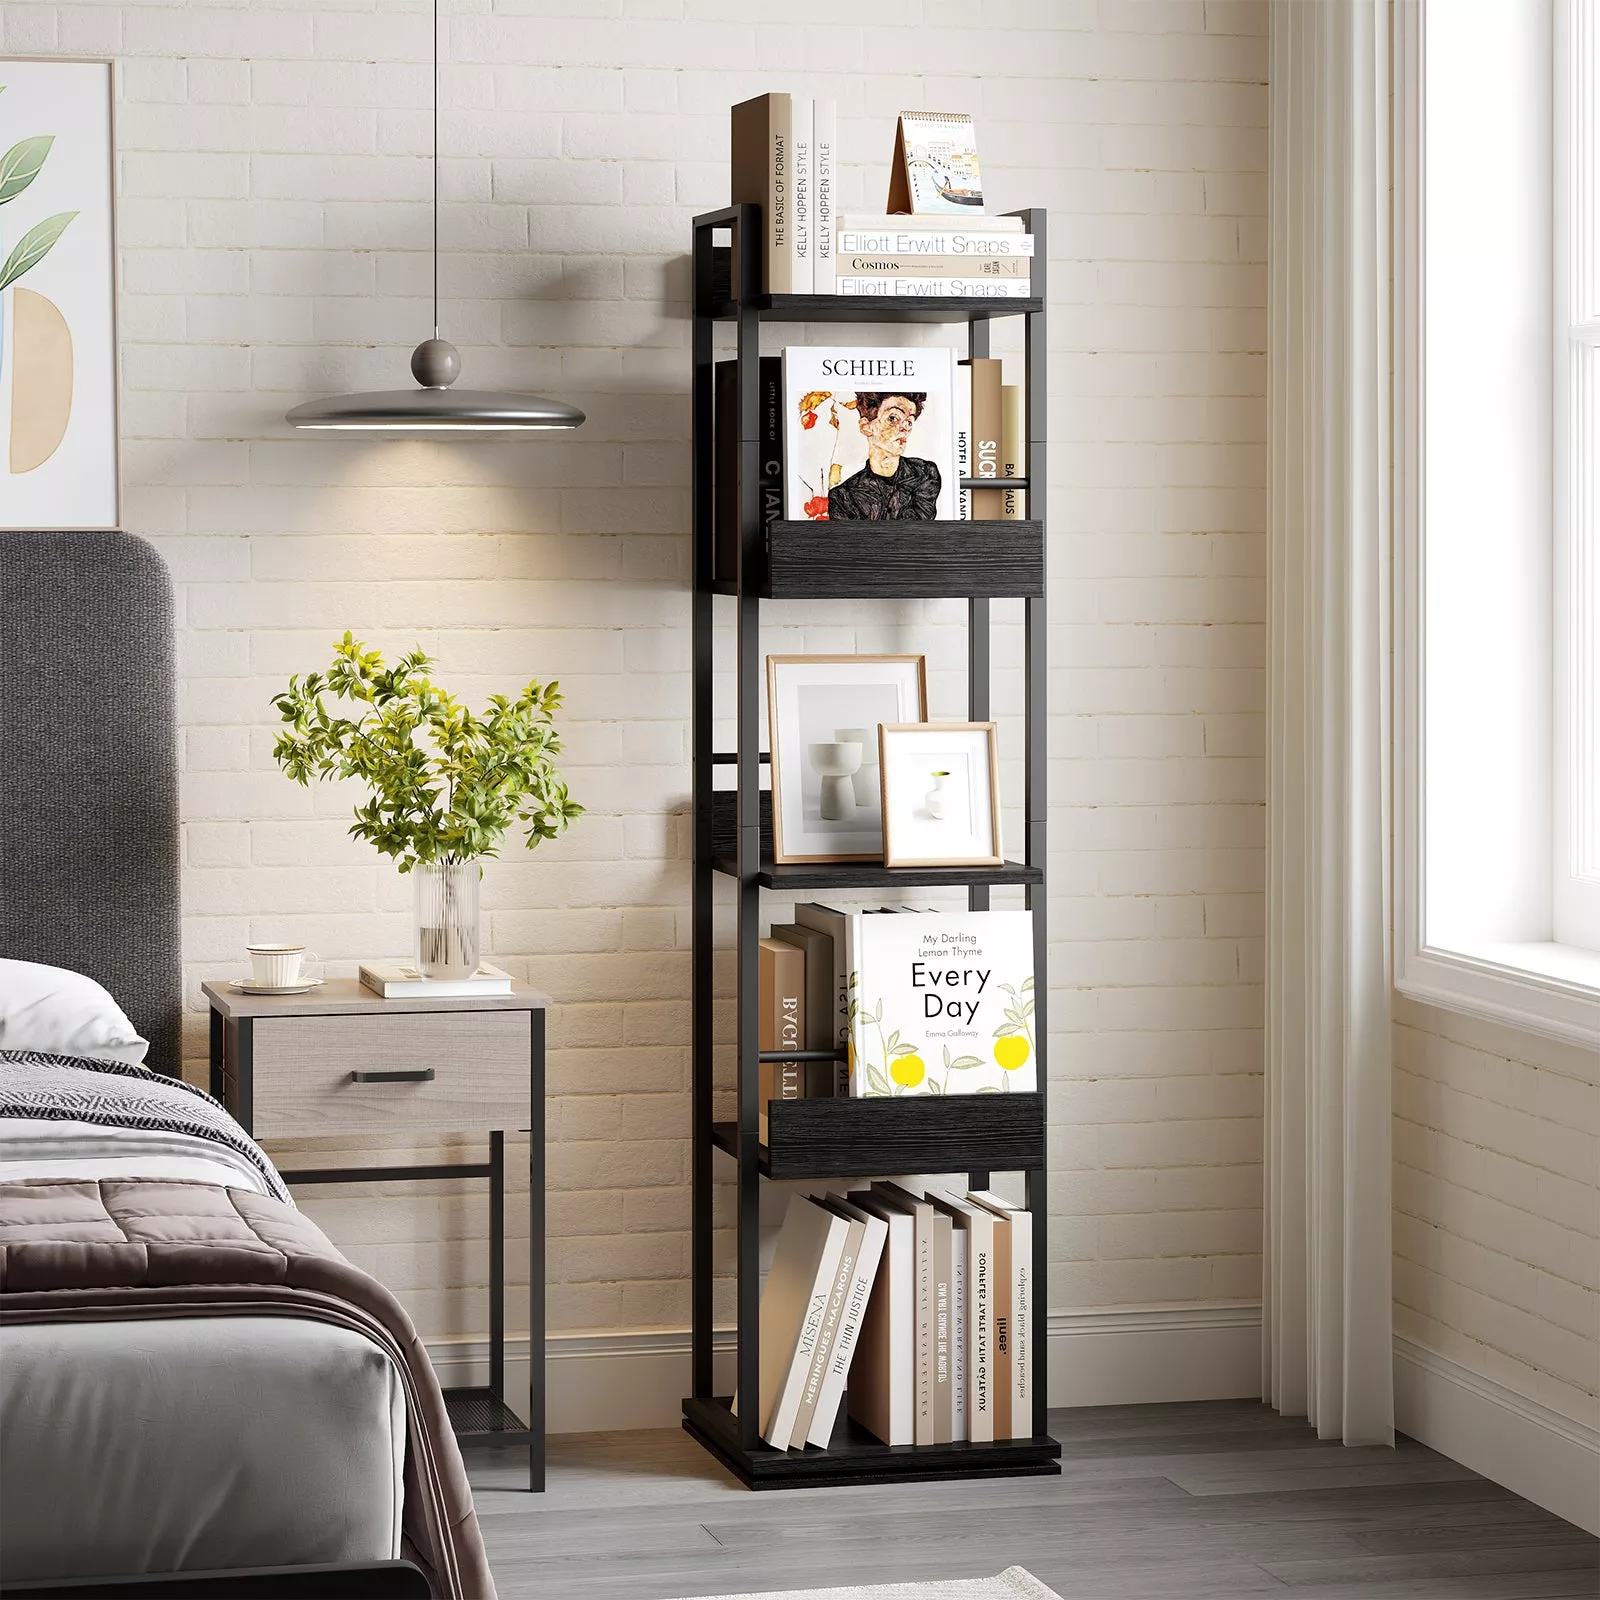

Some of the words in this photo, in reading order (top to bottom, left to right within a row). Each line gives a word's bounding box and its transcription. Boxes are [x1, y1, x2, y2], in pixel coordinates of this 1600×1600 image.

[775, 134, 784, 176] FORMAT
[797, 142, 807, 175] STYLE
[820, 143, 830, 175] STYLE
[775, 179, 784, 193] OF
[797, 178, 807, 222] HOPPEN
[820, 178, 830, 222] HOPPEN
[775, 196, 784, 225] BASIC
[775, 227, 784, 247] THE
[797, 225, 807, 258] KELLY
[820, 225, 830, 259] KELLY
[843, 234, 890, 252] Elliott
[896, 235, 947, 253] Erwitt
[952, 235, 1010, 256] Snaps
[852, 258, 900, 270] Cosmos
[842, 279, 888, 295] Elliott
[895, 279, 944, 296] Erwitt
[950, 280, 1008, 297] Snaps
[822, 359, 915, 377] SCHIELE
[1004, 463, 1014, 514] BAHAUS
[918, 948, 949, 958] Lemon
[952, 946, 983, 959] Thyme
[923, 935, 938, 946] My
[941, 932, 977, 945] Darling
[912, 962, 992, 994] Every
[924, 993, 980, 1026] Day
[925, 1030, 946, 1038] Emma
[947, 1029, 979, 1038] Galloway
[805, 1330, 832, 1405] MERINGUES
[827, 1255, 852, 1328] MACARONS
[832, 1352, 847, 1376] THE
[840, 1323, 855, 1350] THIN
[848, 1275, 869, 1322] JUSTICE
